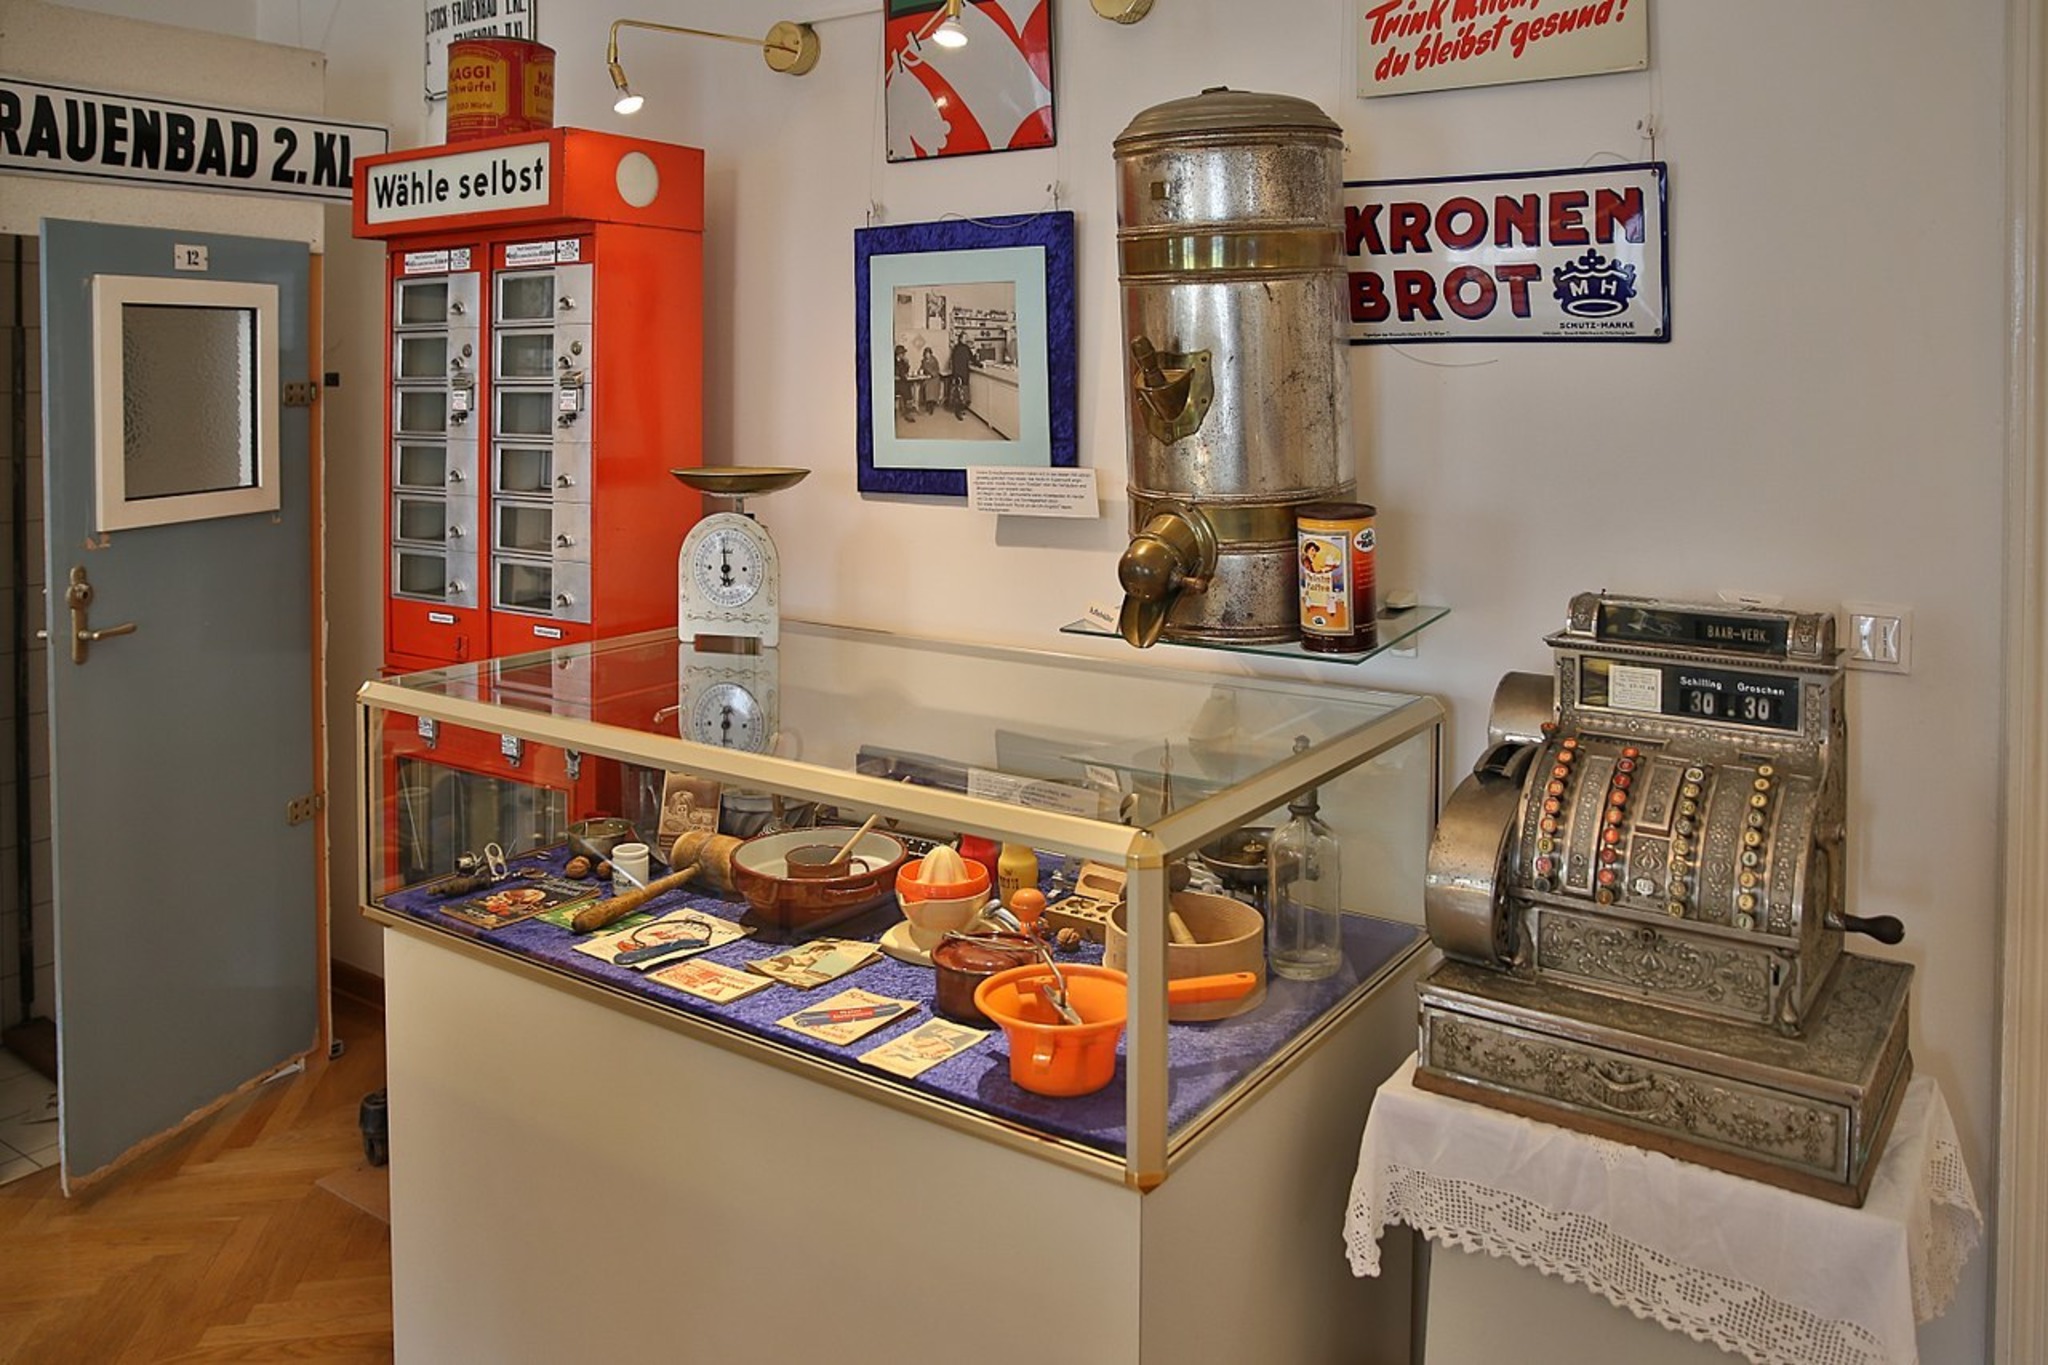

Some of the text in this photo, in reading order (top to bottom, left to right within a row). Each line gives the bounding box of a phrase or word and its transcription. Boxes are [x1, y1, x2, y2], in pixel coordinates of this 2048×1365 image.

[1365, 0, 1446, 45] Trink
[1375, 0, 1627, 81] du bleibst gesund!
[450, 66, 491, 81] AGGI
[374, 157, 543, 209] Wähle selbst
[1343, 186, 1646, 257] KRONEN
[187, 250, 199, 265] 12
[1347, 262, 1542, 323] BROT
[1559, 321, 1635, 329] SCHUTZ-MARKE
[1707, 625, 1770, 643] BAAR-VERK.
[1680, 676, 1784, 696] Schilling Groschen
[1690, 691, 1769, 720] 30 30
